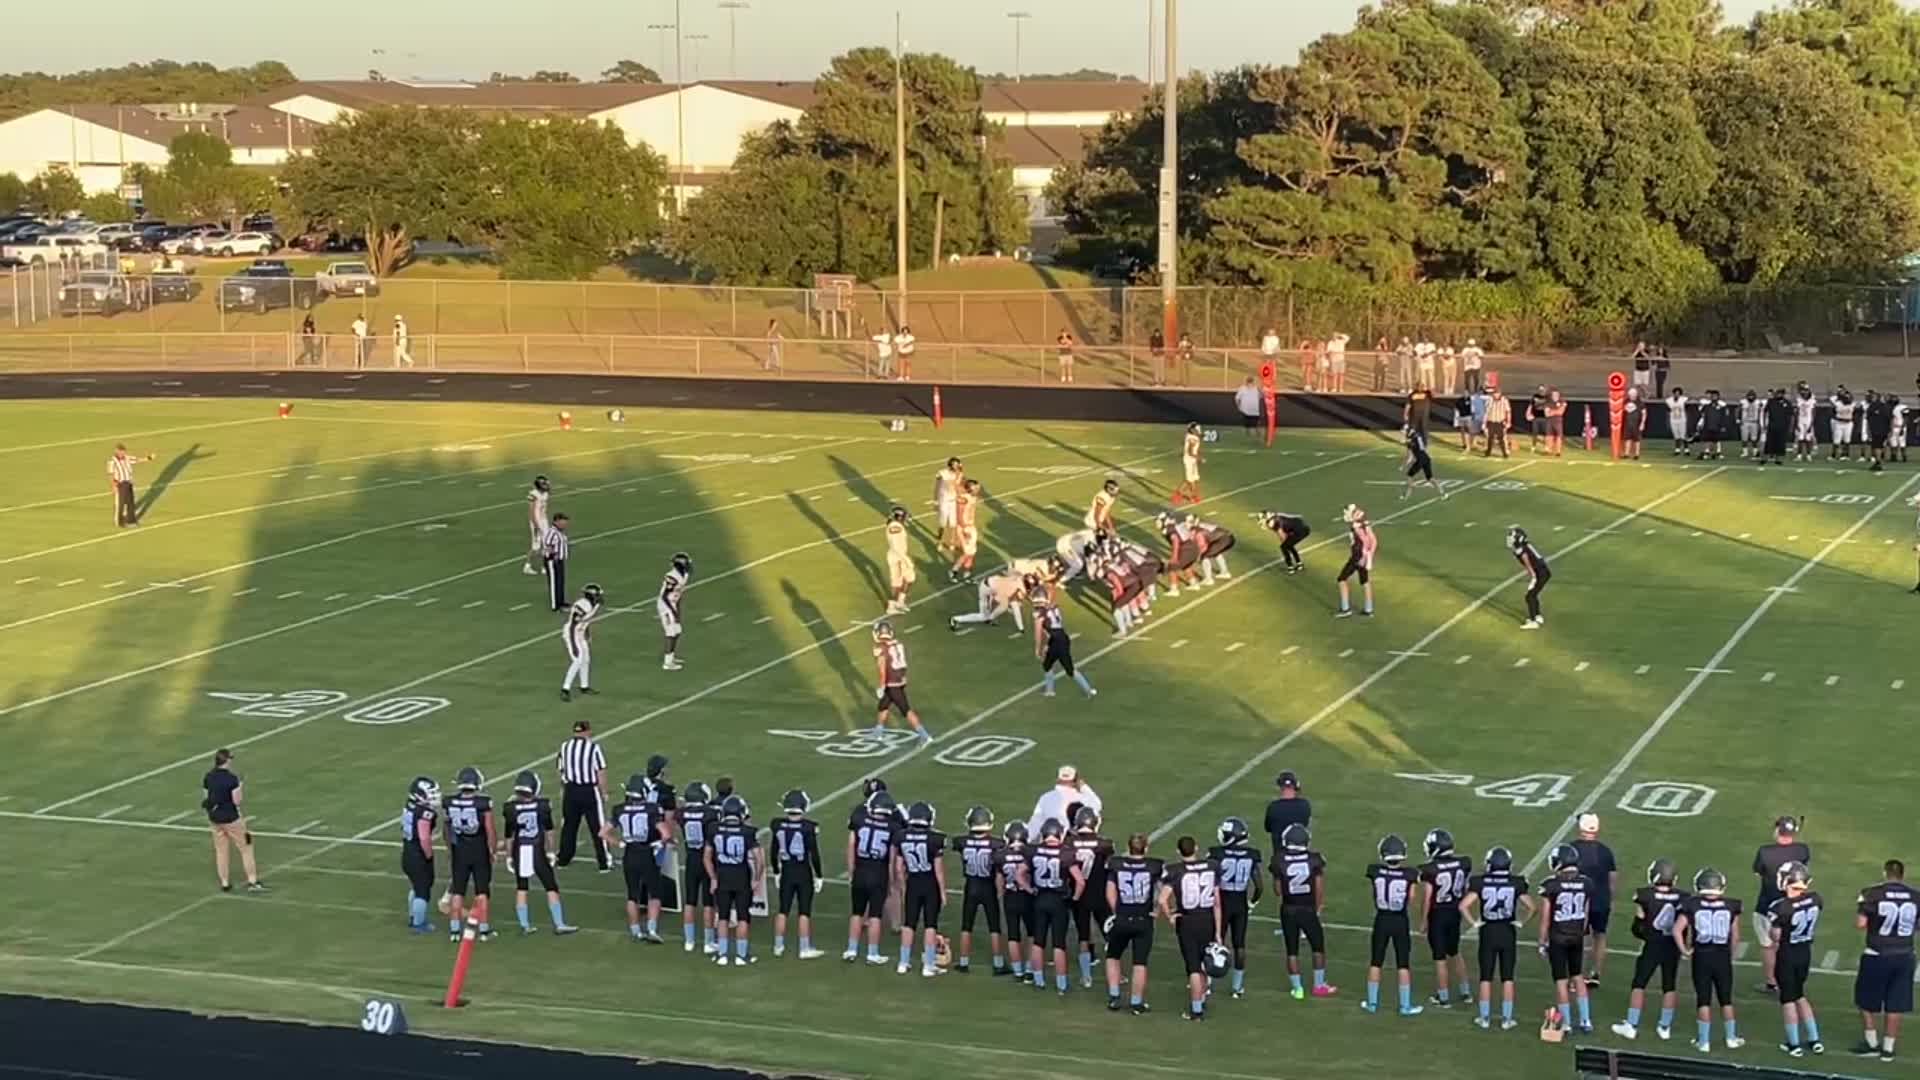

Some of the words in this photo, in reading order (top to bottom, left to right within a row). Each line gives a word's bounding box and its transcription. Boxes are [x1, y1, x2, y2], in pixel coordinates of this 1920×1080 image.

[516, 811, 539, 838] 3
[775, 829, 804, 861] 14
[857, 826, 891, 859] 15
[1033, 857, 1064, 888] 21
[1286, 862, 1311, 895] 2
[362, 1000, 394, 1034] 30
